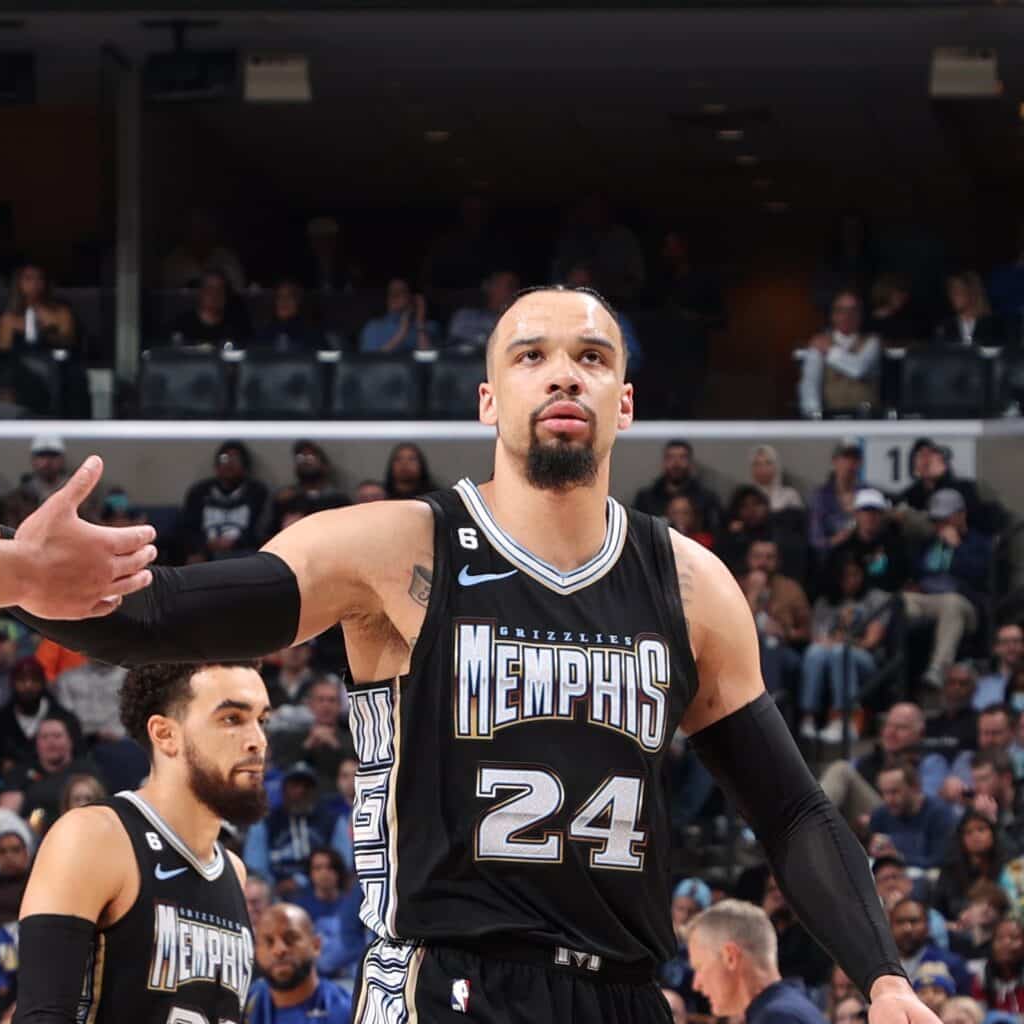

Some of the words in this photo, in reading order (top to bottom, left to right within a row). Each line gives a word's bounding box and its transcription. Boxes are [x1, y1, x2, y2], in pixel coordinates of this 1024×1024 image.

[457, 527, 480, 550] 6
[499, 626, 633, 647] GRIZZLIES
[454, 617, 672, 754] MEMPHIS
[144, 831, 164, 851] 6
[474, 761, 649, 873] 24
[147, 903, 255, 1013] MEMPHIS
